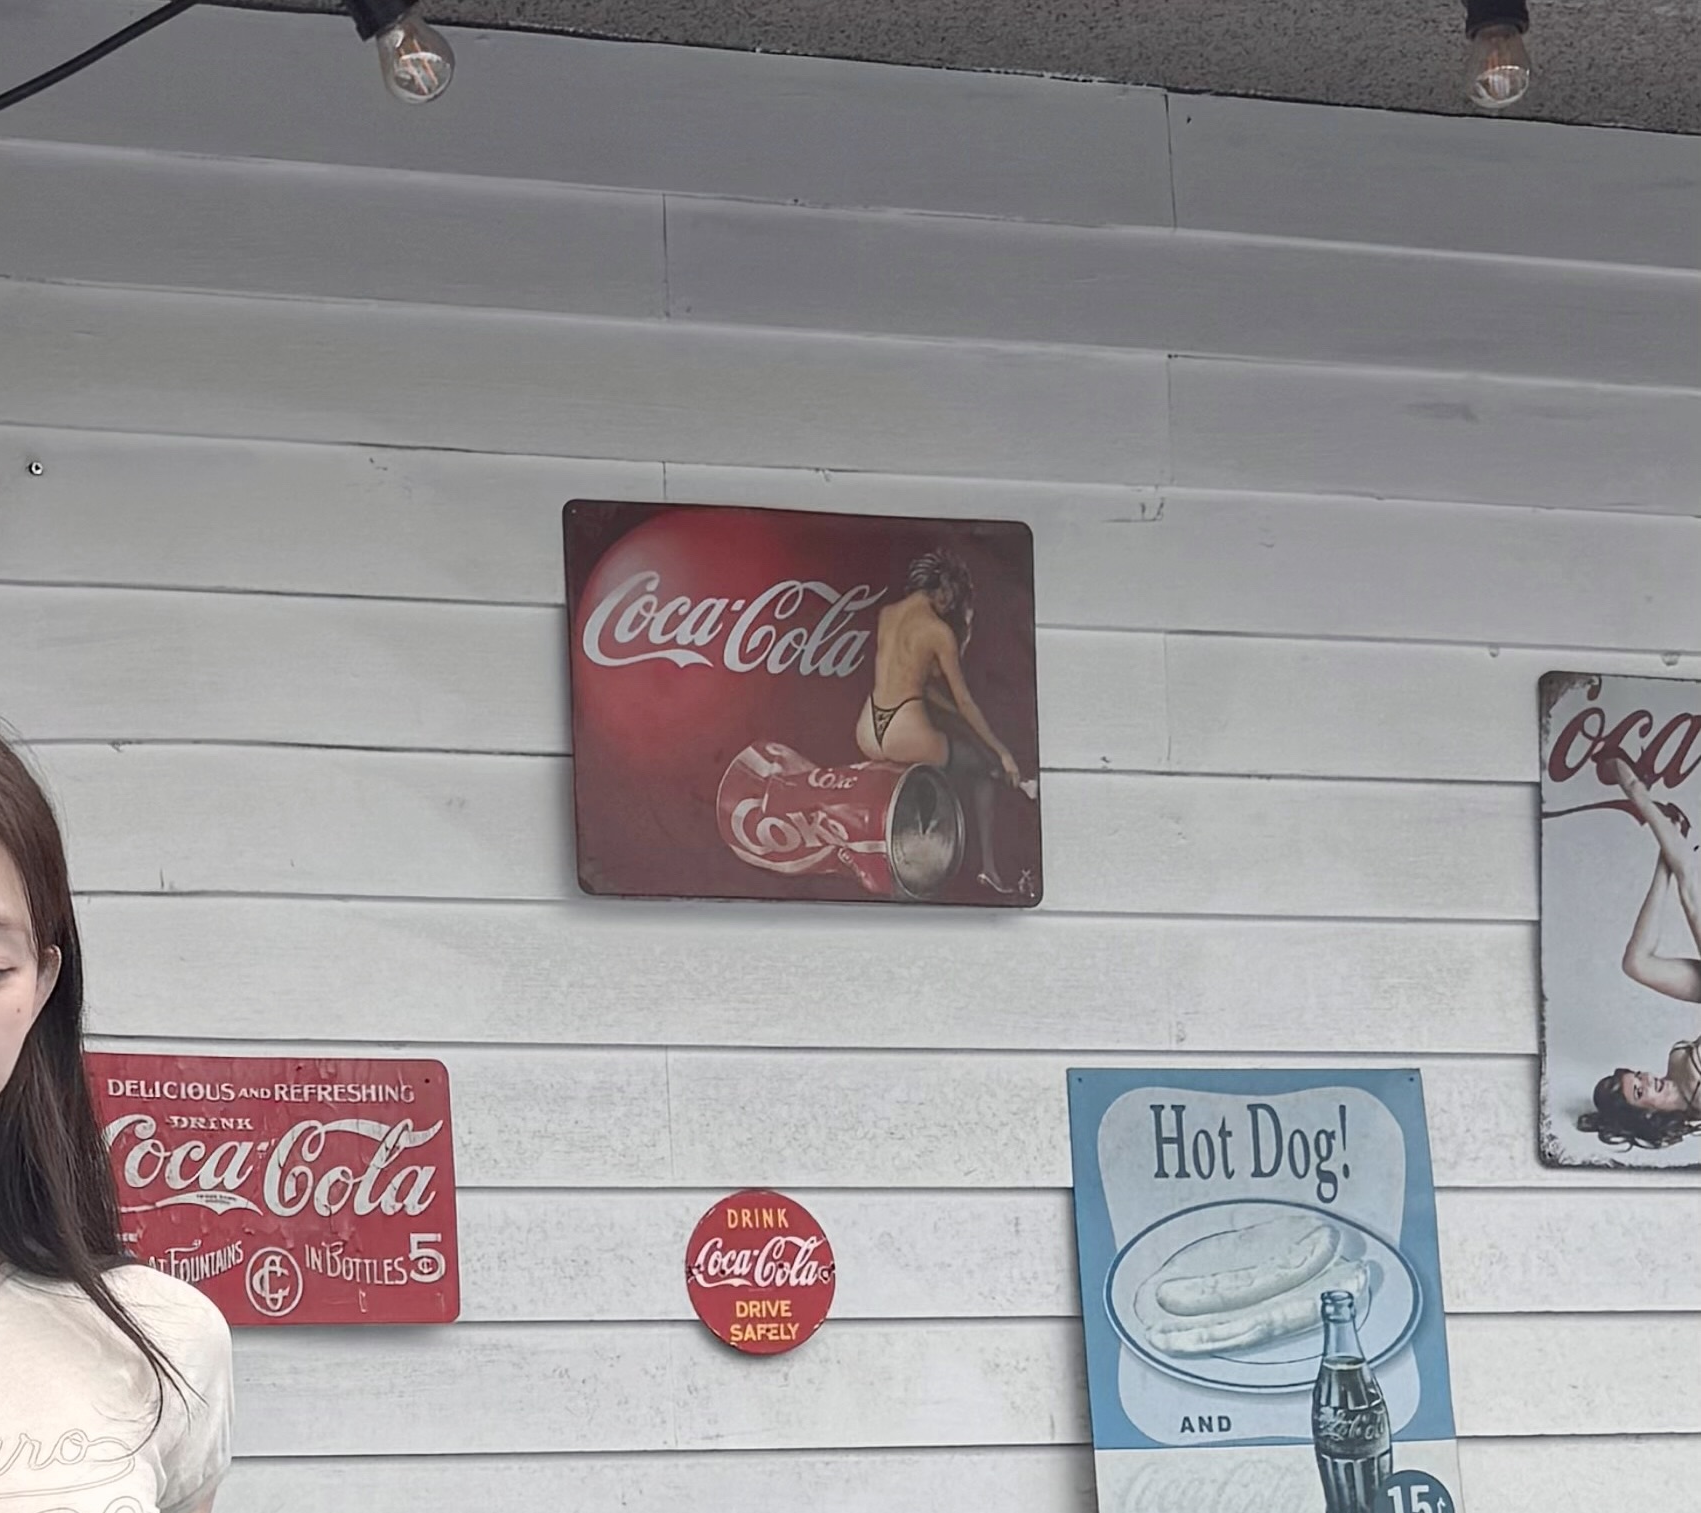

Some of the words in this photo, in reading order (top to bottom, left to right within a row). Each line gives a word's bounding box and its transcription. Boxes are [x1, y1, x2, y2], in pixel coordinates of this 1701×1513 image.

[583, 570, 888, 678] Coca-Cola
[107, 1078, 236, 1102] DELICIOUS
[239, 1086, 271, 1100] AND
[274, 1082, 415, 1104] REFRESHING
[167, 1115, 255, 1131] DRINK
[1149, 1103, 1236, 1181] Hot
[1247, 1103, 1351, 1204] Dog!
[727, 1208, 790, 1229] DRINK
[304, 1243, 324, 1274] IN
[322, 1241, 409, 1286] BOTTLES
[692, 1236, 826, 1288] Coca-Cola
[735, 1300, 793, 1319] DRIVE
[729, 1323, 800, 1342] SAFELY
[1180, 1414, 1233, 1434] AND
